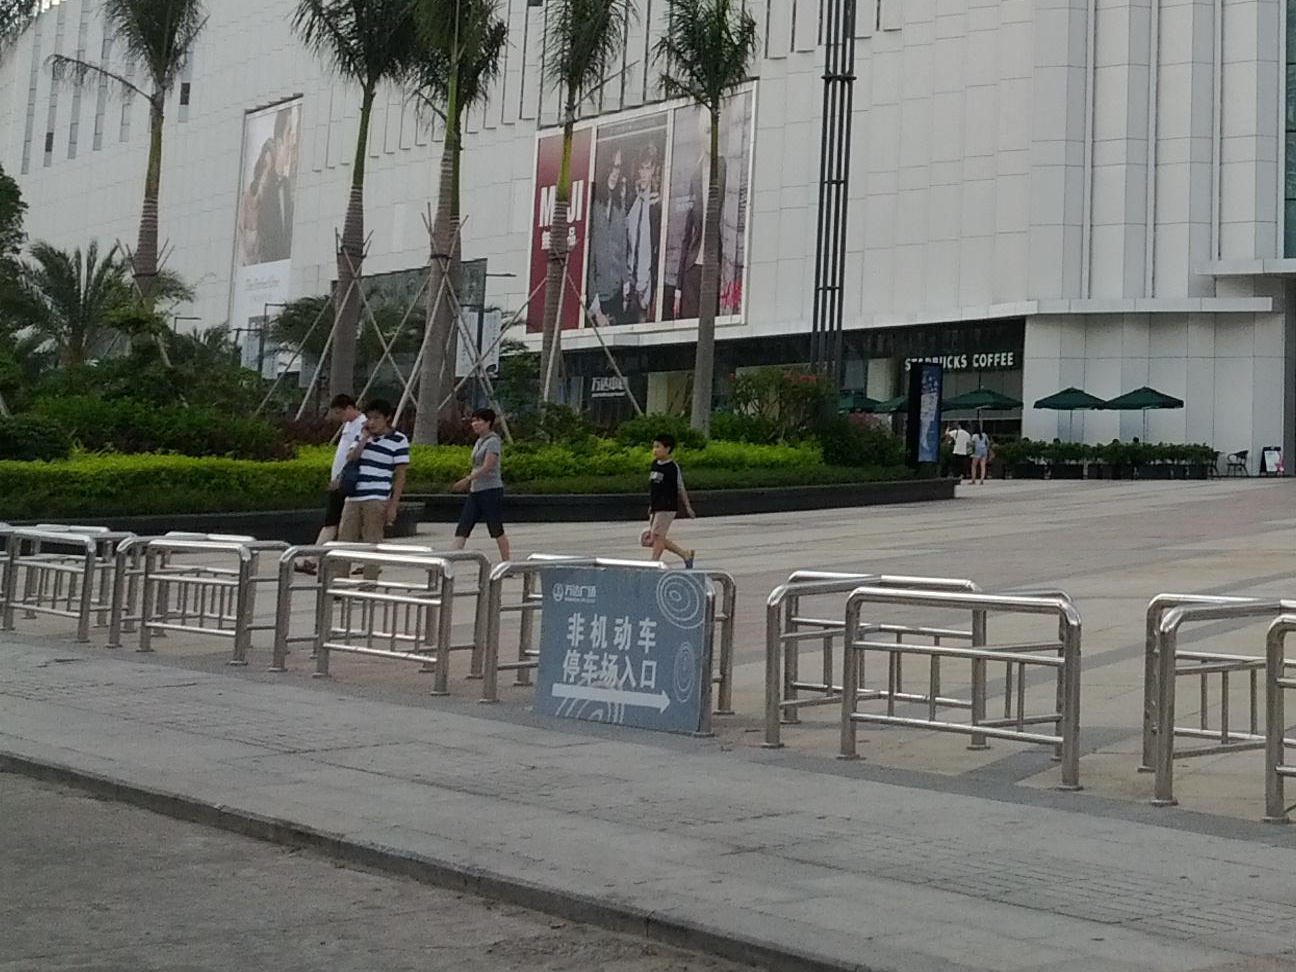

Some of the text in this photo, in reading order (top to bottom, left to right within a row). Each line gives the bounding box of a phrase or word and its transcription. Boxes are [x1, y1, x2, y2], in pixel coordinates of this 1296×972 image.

[538, 179, 584, 228] MJI
[541, 226, 577, 251] 無品
[972, 351, 1014, 369] COFFEE
[565, 612, 658, 655] 非机动车
[562, 648, 658, 690] 停车场入口
